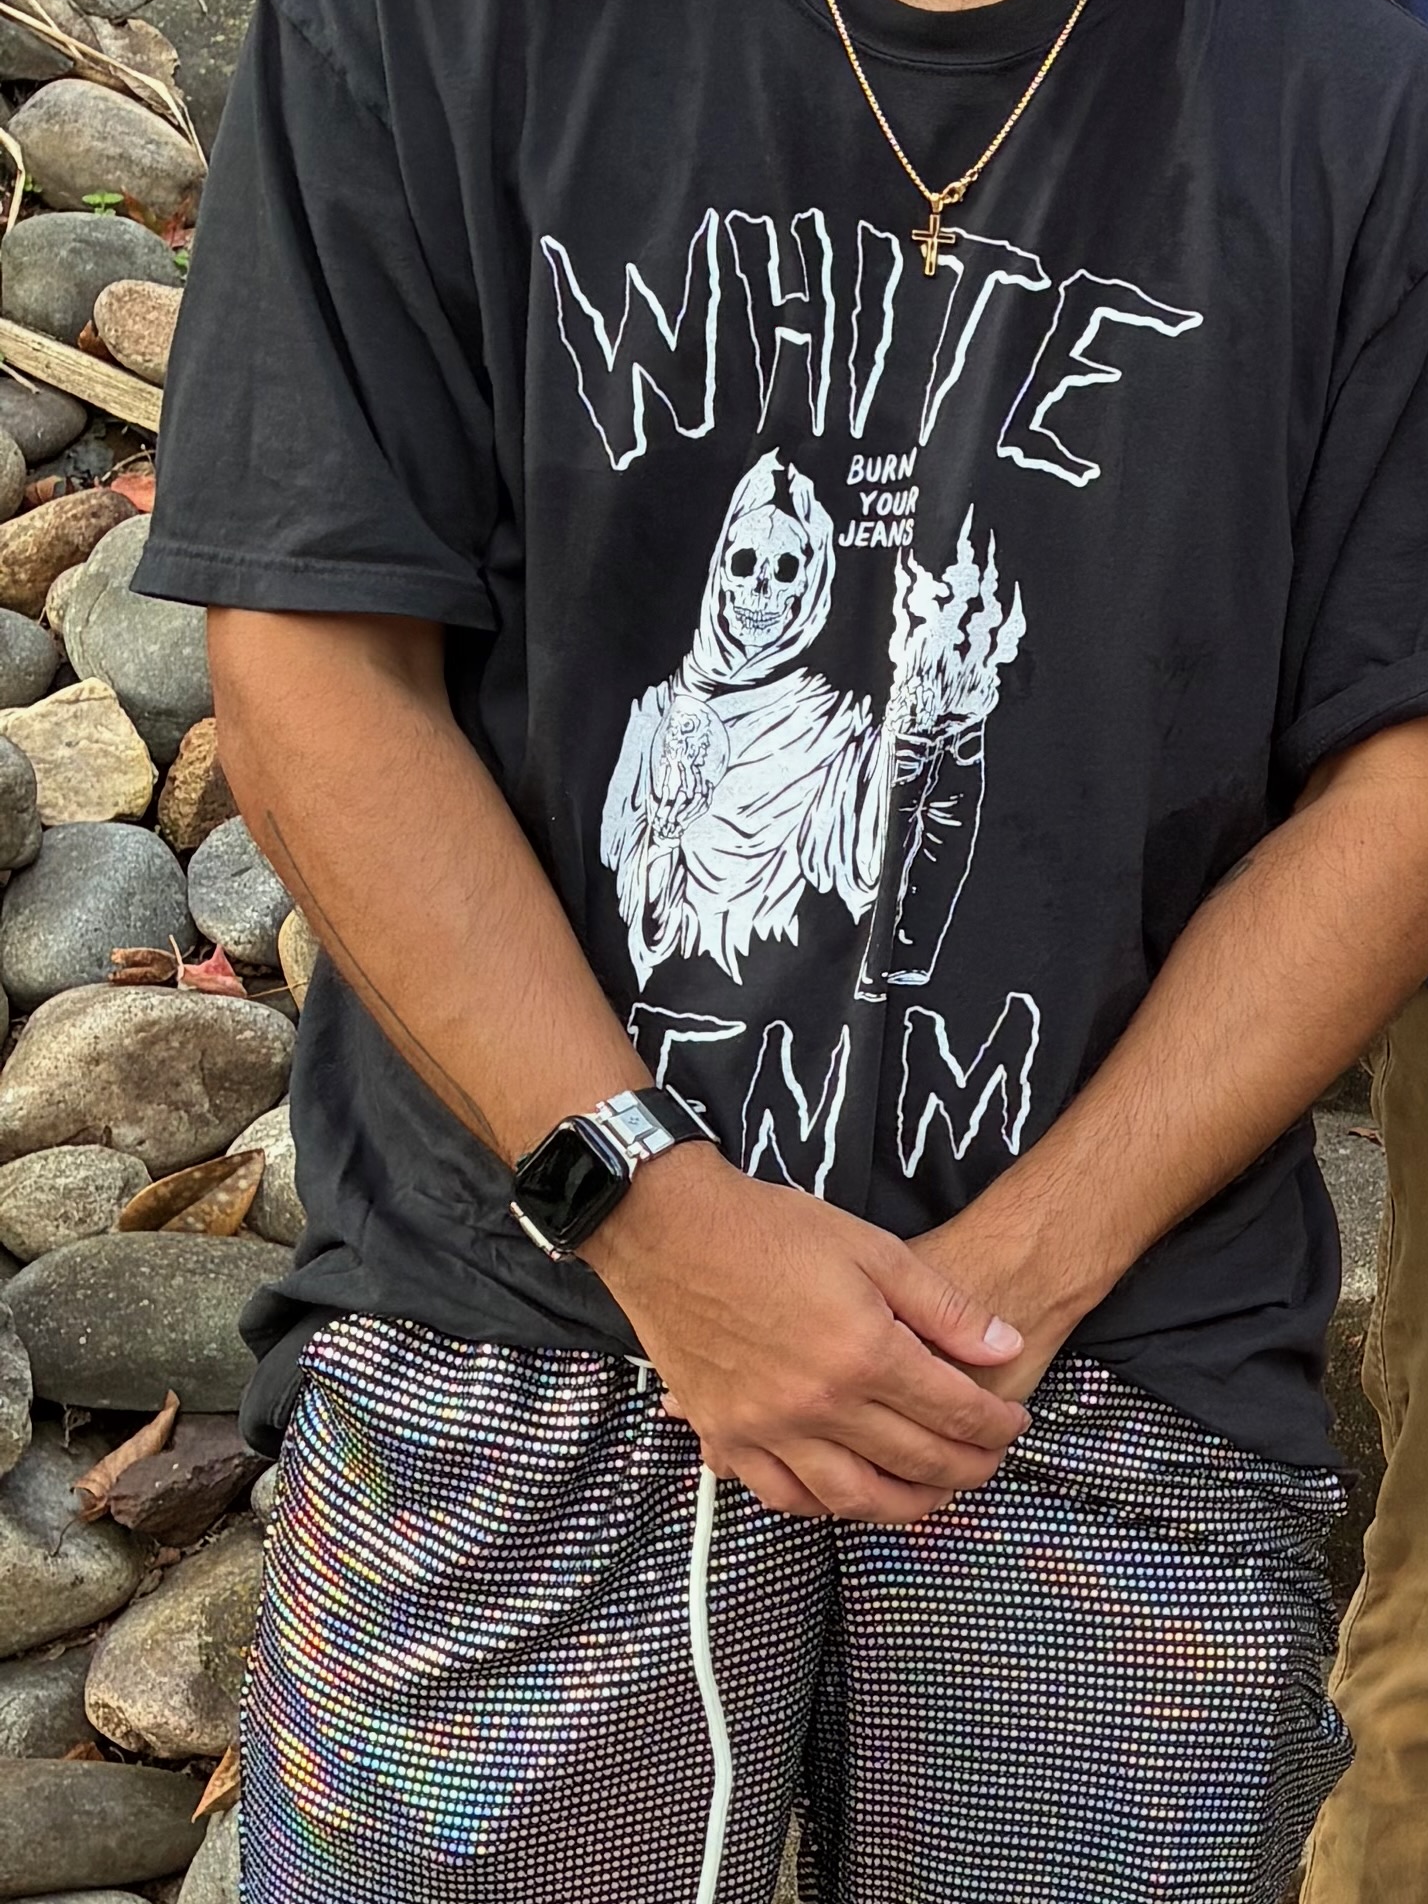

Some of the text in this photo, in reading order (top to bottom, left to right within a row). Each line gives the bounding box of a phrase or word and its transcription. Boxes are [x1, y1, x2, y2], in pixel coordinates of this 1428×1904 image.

[540, 207, 1204, 488] WHITE
[845, 446, 918, 486] BURN
[859, 485, 920, 516] YOUR
[837, 517, 915, 548] JEANS
